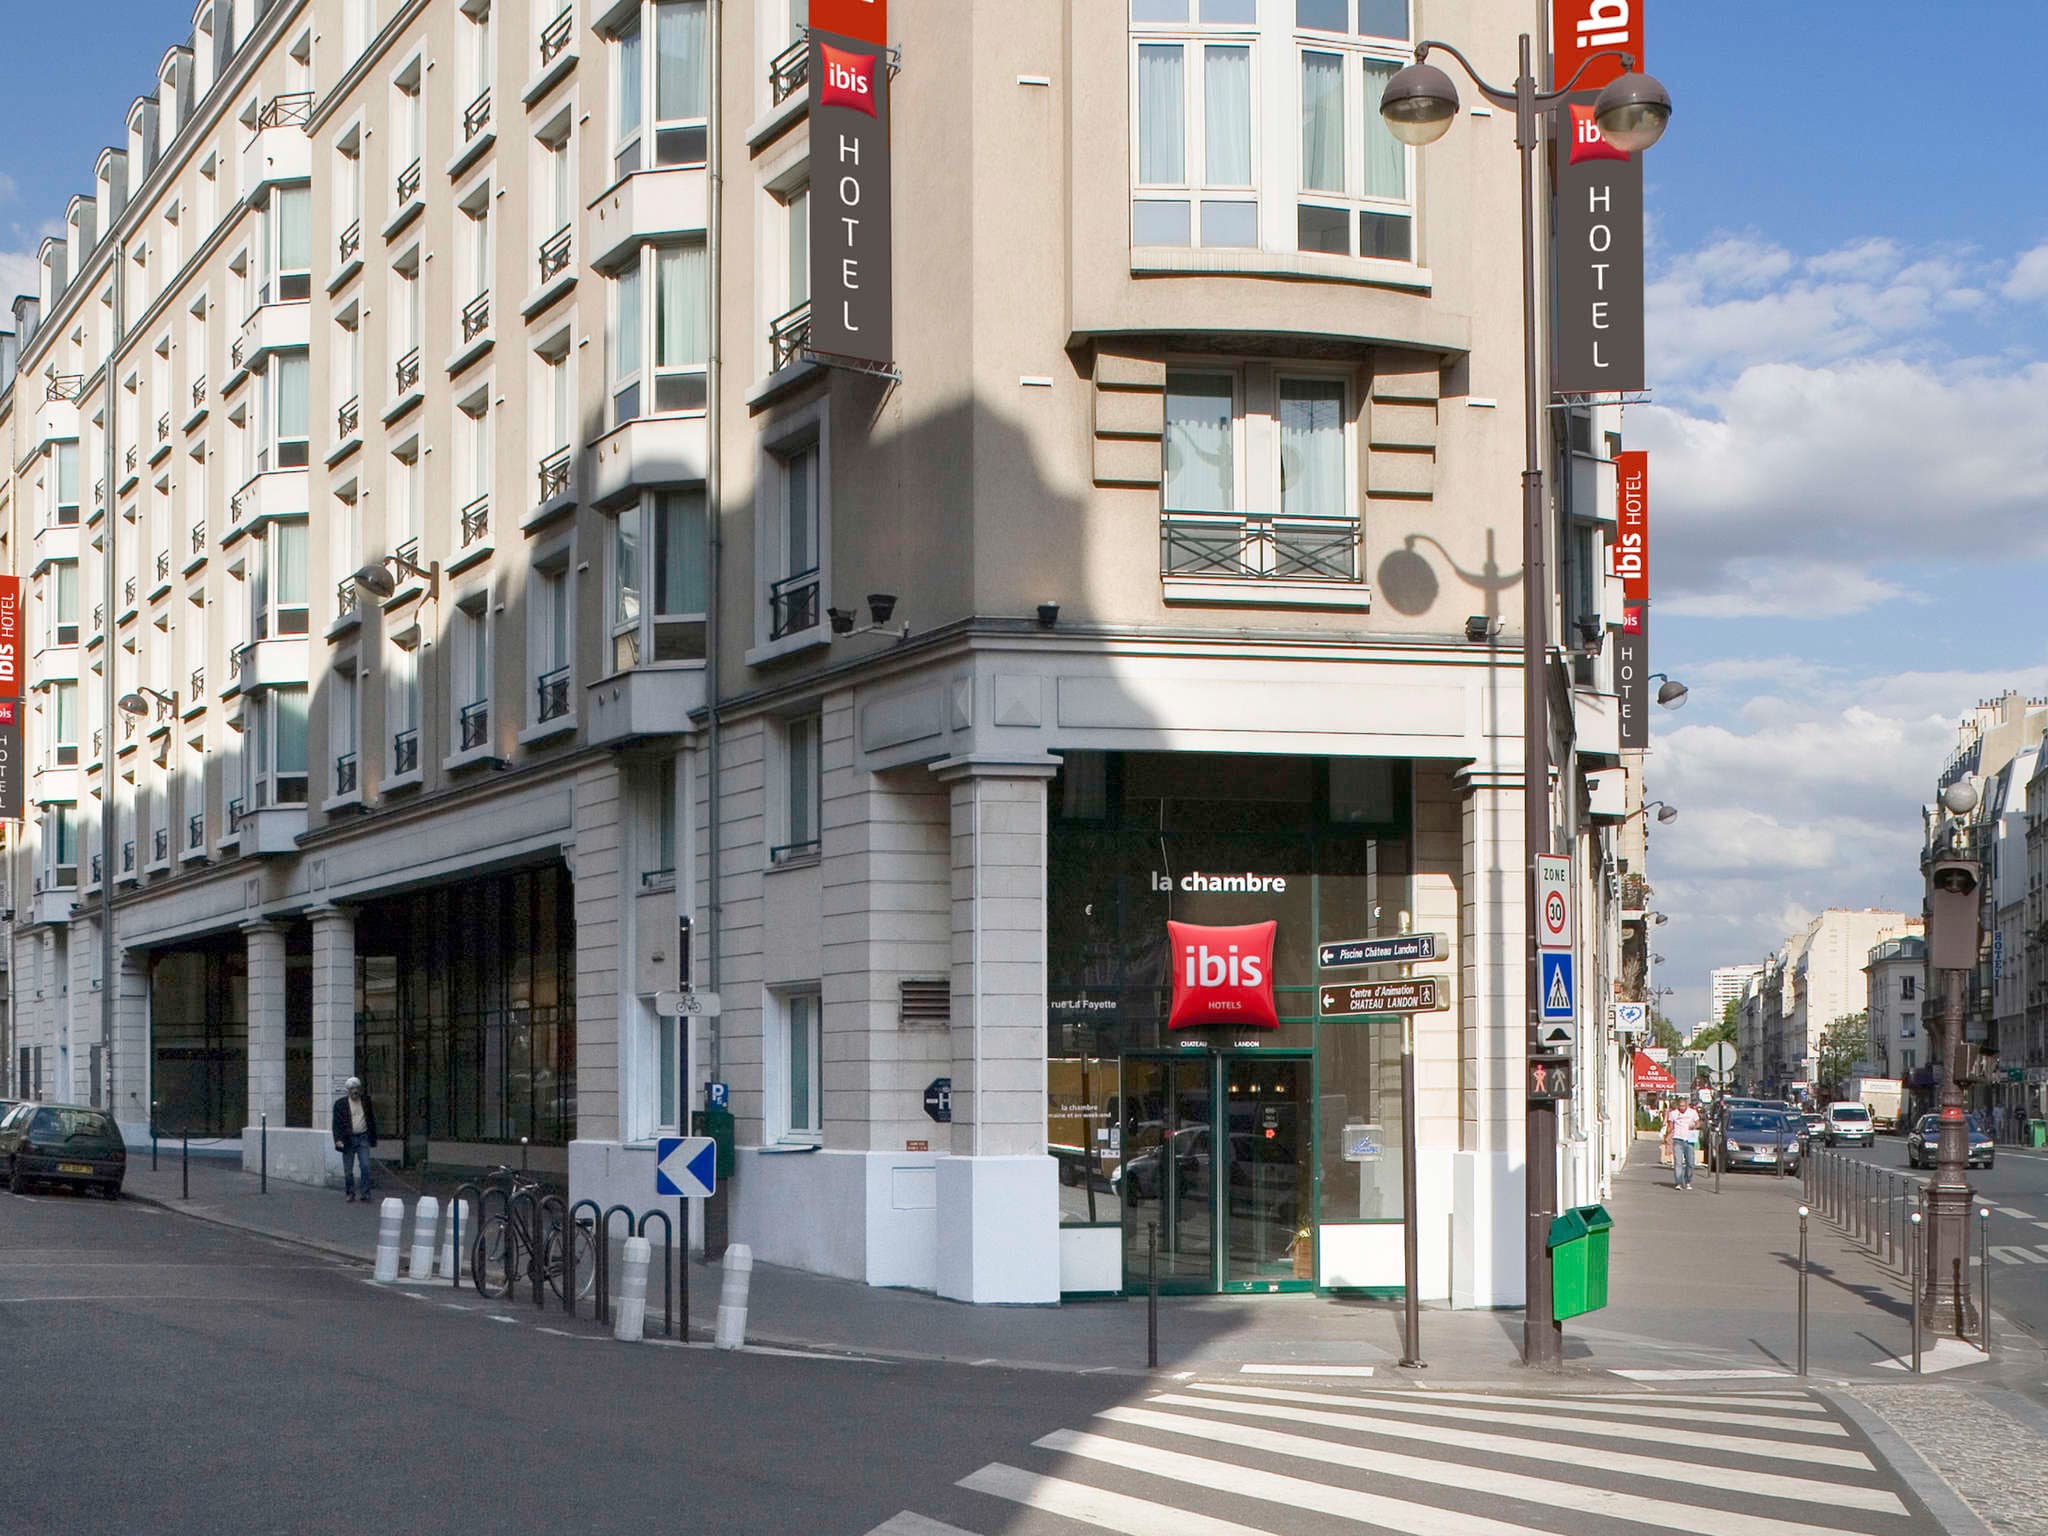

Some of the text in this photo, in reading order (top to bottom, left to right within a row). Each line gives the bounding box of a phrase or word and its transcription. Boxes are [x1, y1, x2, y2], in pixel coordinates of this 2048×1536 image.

[1577, 0, 1629, 49] ib
[829, 62, 868, 94] ibis
[1578, 120, 1606, 143] ib
[839, 134, 861, 331] HOTEL
[1589, 186, 1611, 368] HOTEL
[1615, 471, 1641, 578] ibis HOTEL
[1, 593, 14, 638] HOTEL
[1621, 647, 1633, 737] HOTEL
[1152, 871, 1287, 892] la chambre
[1543, 867, 1566, 882] ZONE
[1549, 903, 1563, 922] 30
[1339, 948, 1363, 961] Piscine
[1394, 942, 1418, 956] Landon
[1186, 945, 1263, 988] ibis
[1349, 983, 1415, 999] Centre d'Animation
[1050, 1001, 1066, 1009] rue
[1082, 1000, 1117, 1011] Fayette
[1208, 1000, 1243, 1010] HOTELS
[1350, 995, 1419, 1010] CHATEAU LANDON
[1234, 1040, 1260, 1048] LANDON
[712, 1084, 724, 1101] P
